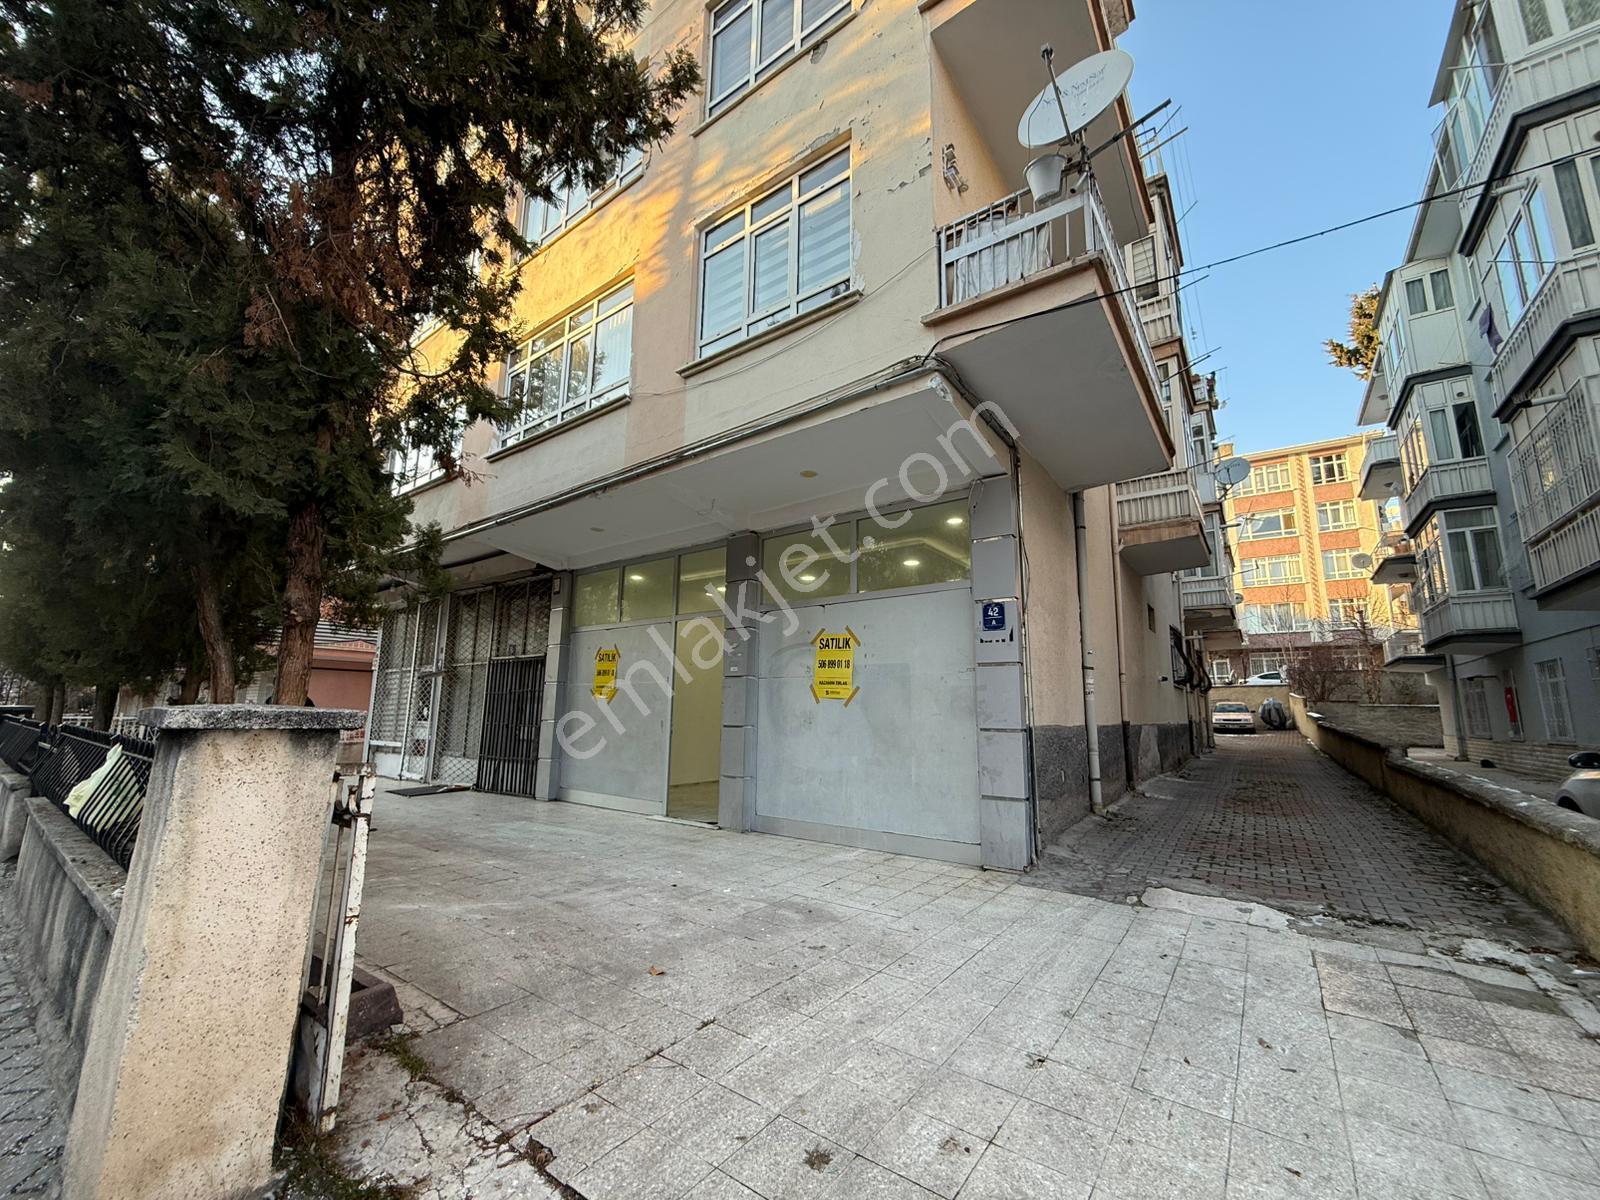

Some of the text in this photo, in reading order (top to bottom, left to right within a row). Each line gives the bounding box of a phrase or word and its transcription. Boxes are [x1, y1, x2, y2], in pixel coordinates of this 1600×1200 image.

[987, 607, 999, 616] 42
[819, 637, 851, 650] SATILIK
[818, 659, 827, 669] 506
[837, 659, 843, 669] 01
